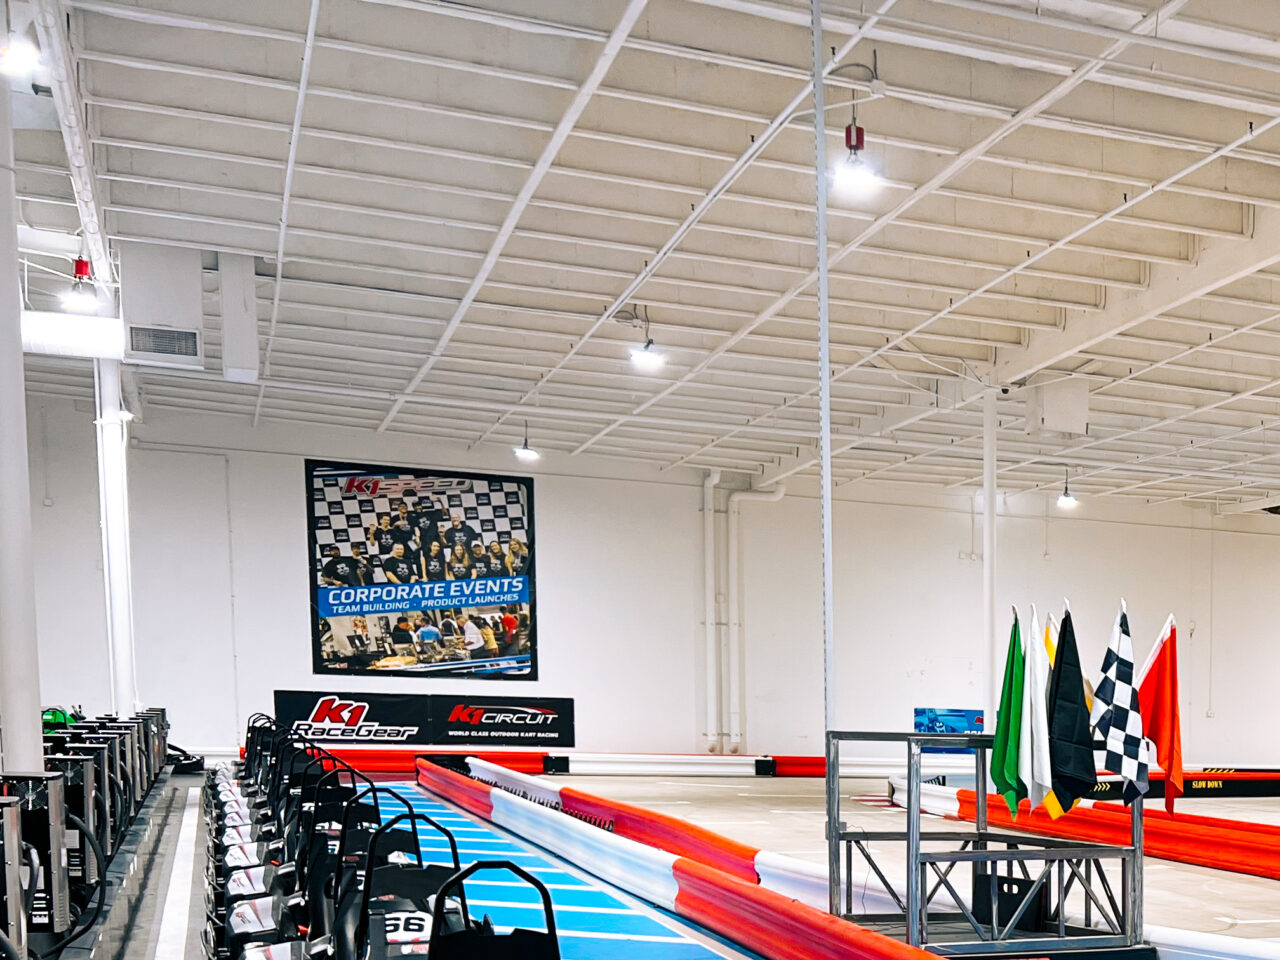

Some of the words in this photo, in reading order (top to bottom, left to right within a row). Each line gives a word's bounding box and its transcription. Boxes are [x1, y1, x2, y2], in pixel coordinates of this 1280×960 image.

[328, 582, 445, 604] CORPORATE
[450, 577, 524, 597] EVENTS
[332, 605, 361, 614] TEAM
[363, 601, 410, 612] BUILDING
[421, 596, 467, 608] PRODUCT
[469, 593, 519, 605] LAUNCHES
[309, 696, 368, 727] K1
[293, 722, 418, 740] RaceGear
